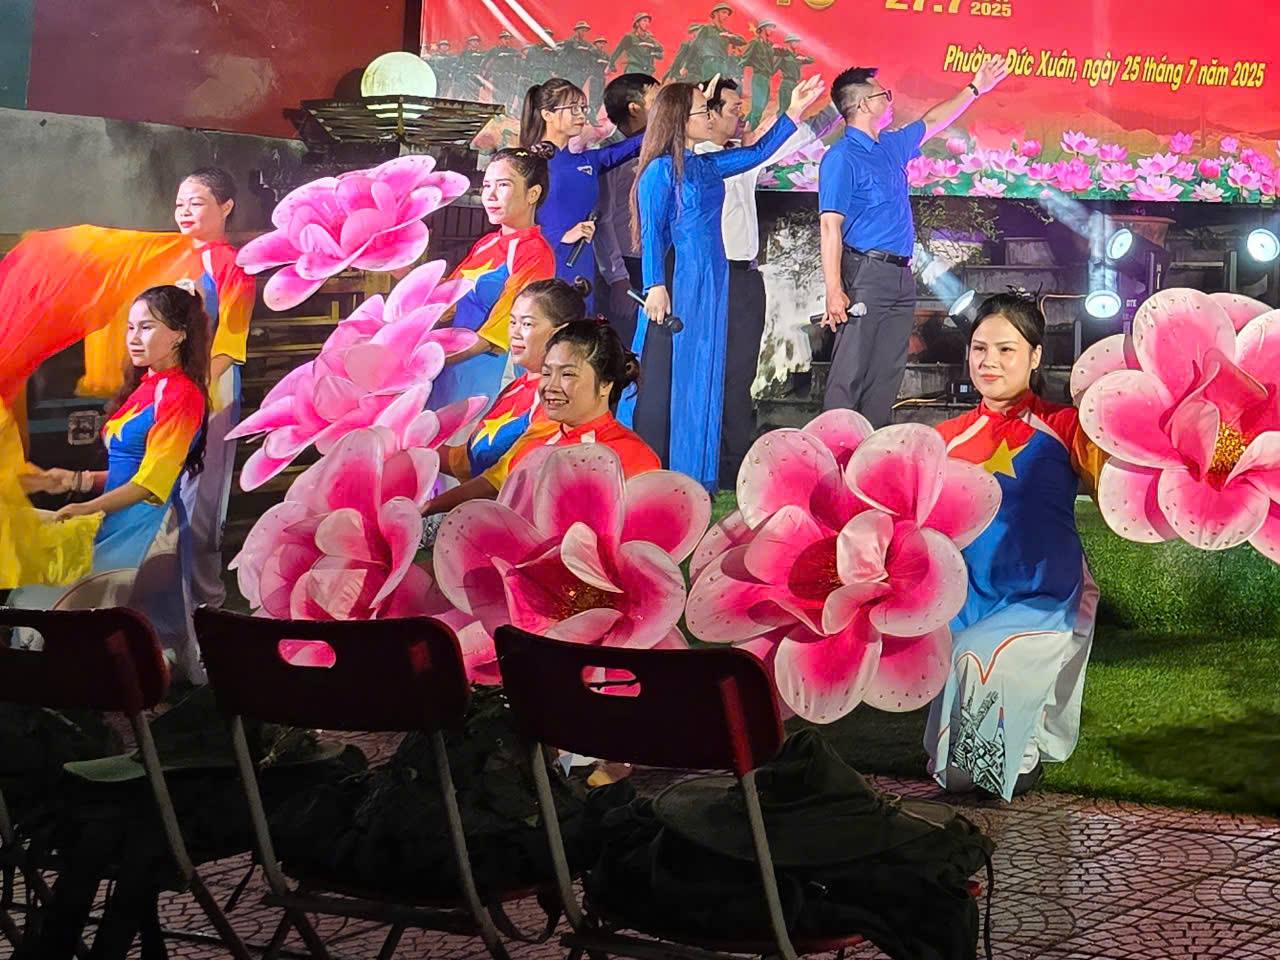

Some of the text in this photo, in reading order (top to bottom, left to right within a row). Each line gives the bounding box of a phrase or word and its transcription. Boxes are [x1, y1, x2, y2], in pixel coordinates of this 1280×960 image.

[970, 2, 1013, 18] 2025
[1036, 50, 1077, 83] Xuân,
[1081, 51, 1120, 87] ngày
[1121, 55, 1140, 81] 25
[1142, 54, 1182, 90] tháng
[1185, 58, 1197, 84] 7
[1197, 58, 1229, 86] năm
[1230, 61, 1266, 88] 2025
